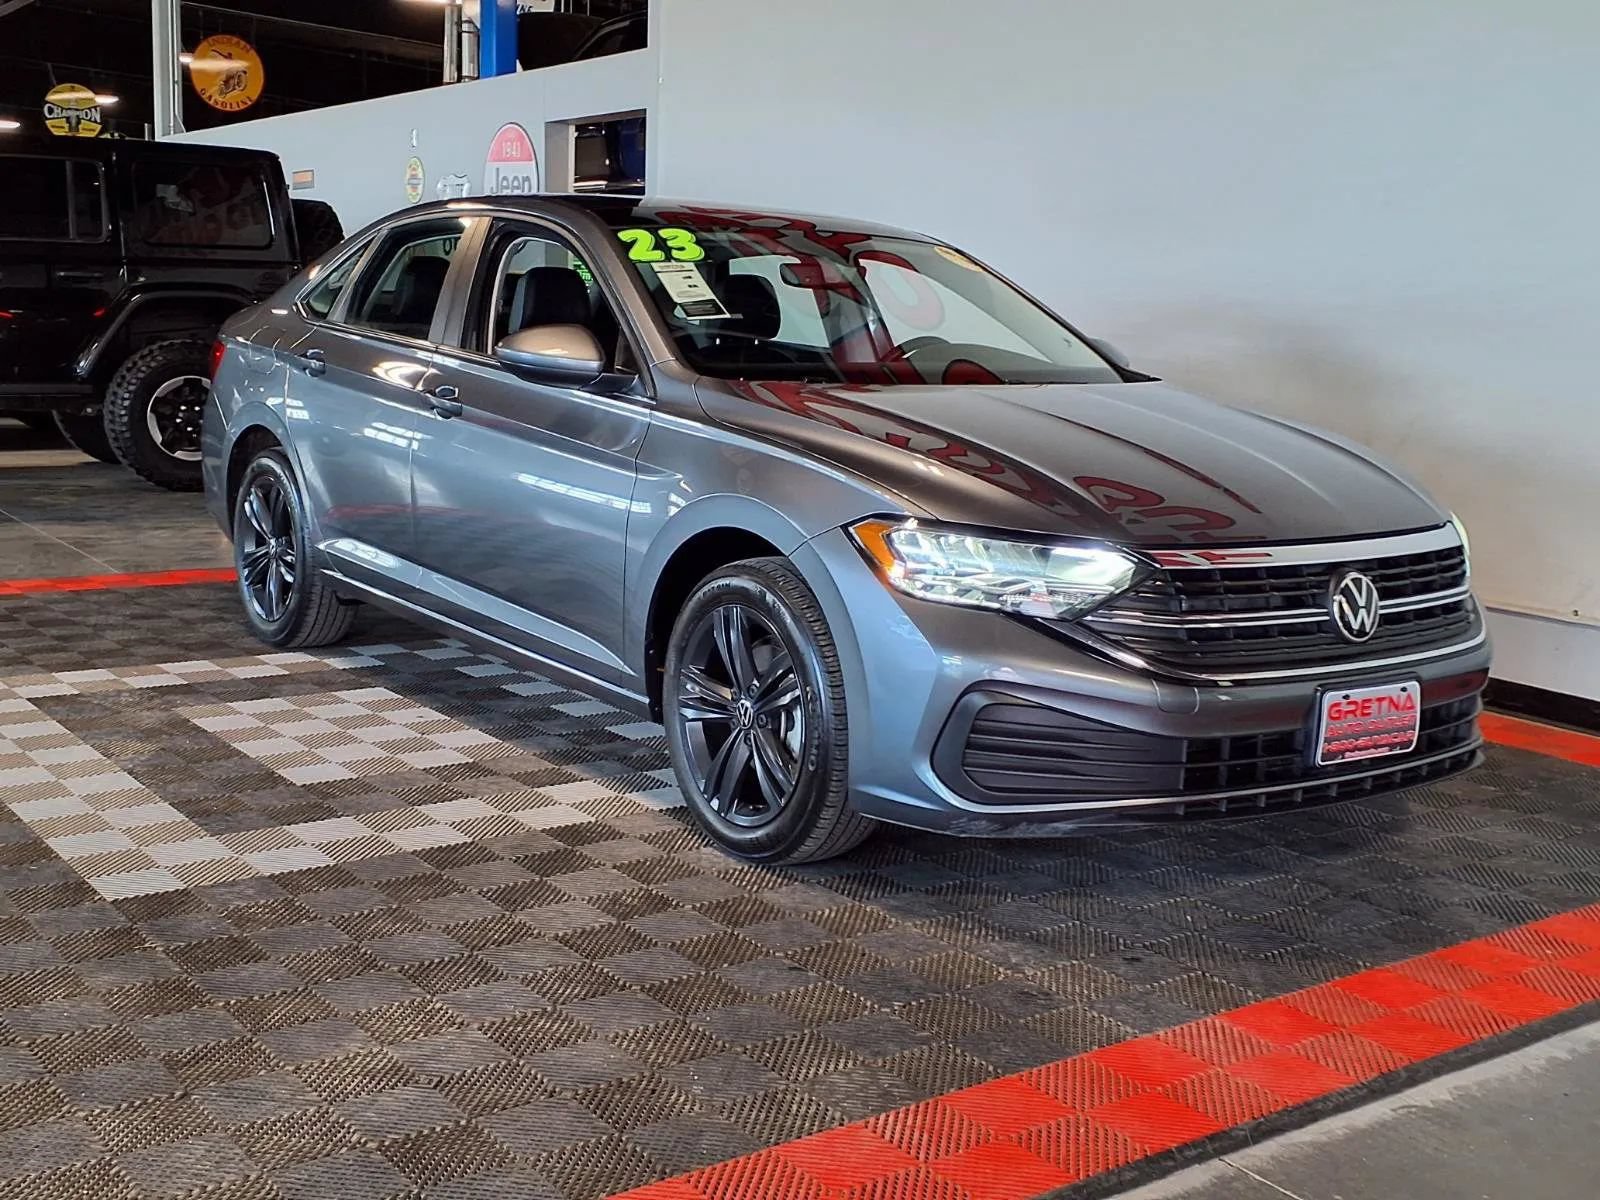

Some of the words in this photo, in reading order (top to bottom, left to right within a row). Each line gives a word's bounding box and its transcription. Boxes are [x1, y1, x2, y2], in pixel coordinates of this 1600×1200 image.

[200, 88, 253, 110] GASOLINE
[44, 103, 101, 122] CHAMPION
[617, 227, 705, 262] 23
[1328, 693, 1416, 721] GRETNA
